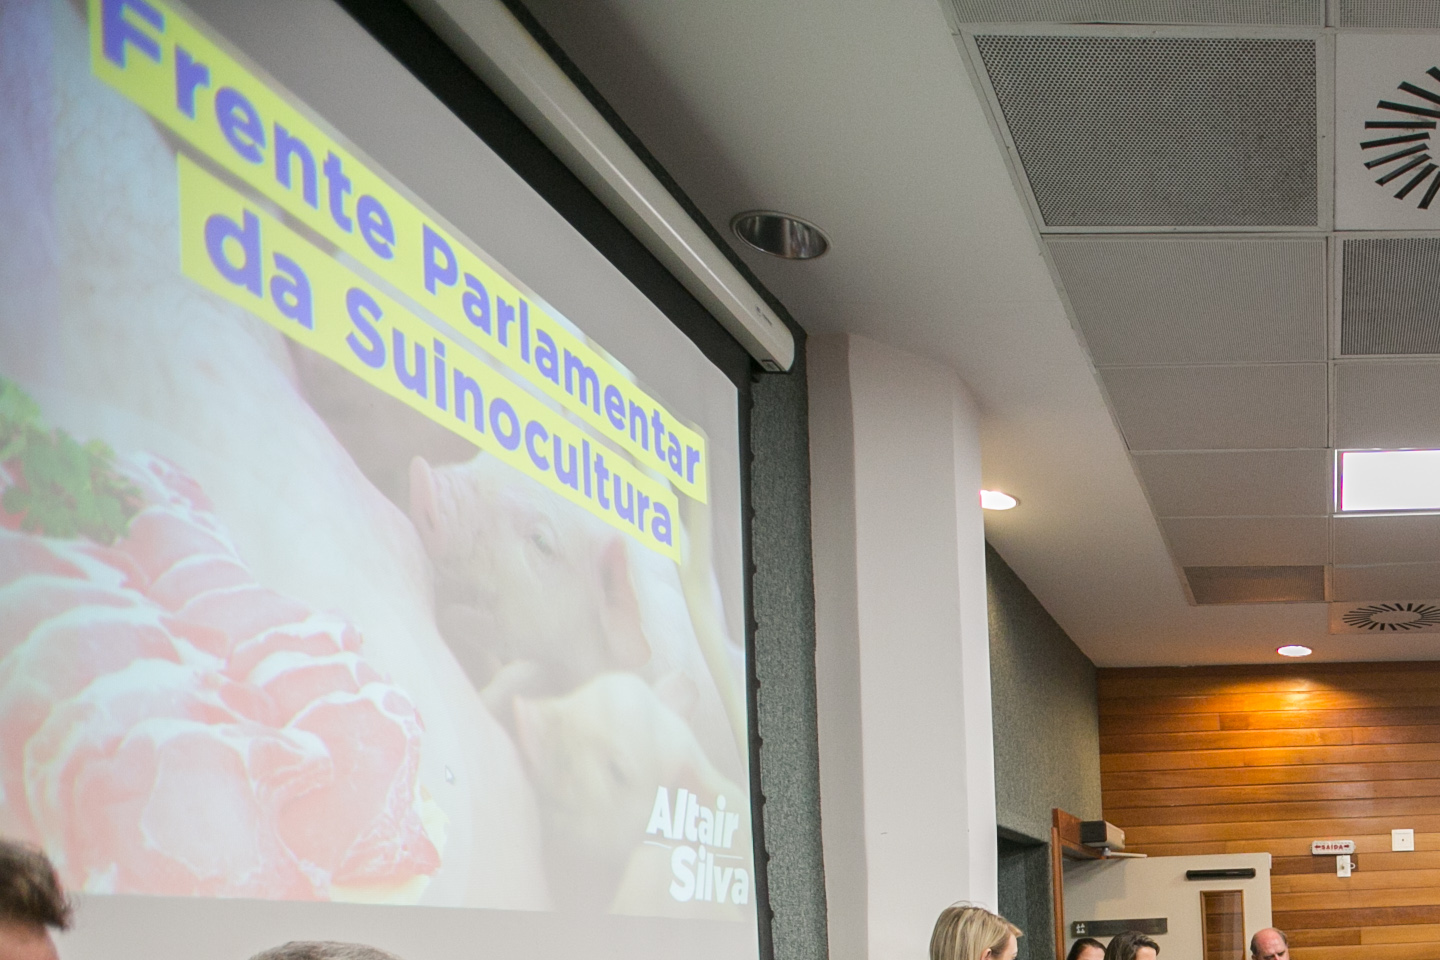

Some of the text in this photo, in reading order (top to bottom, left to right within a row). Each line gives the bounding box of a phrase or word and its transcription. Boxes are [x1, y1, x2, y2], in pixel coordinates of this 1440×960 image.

[102, 0, 701, 485] Frente Parlamentar
[205, 210, 674, 547] da Suinocultura
[645, 785, 740, 849] Altair
[669, 845, 749, 905] Silva
